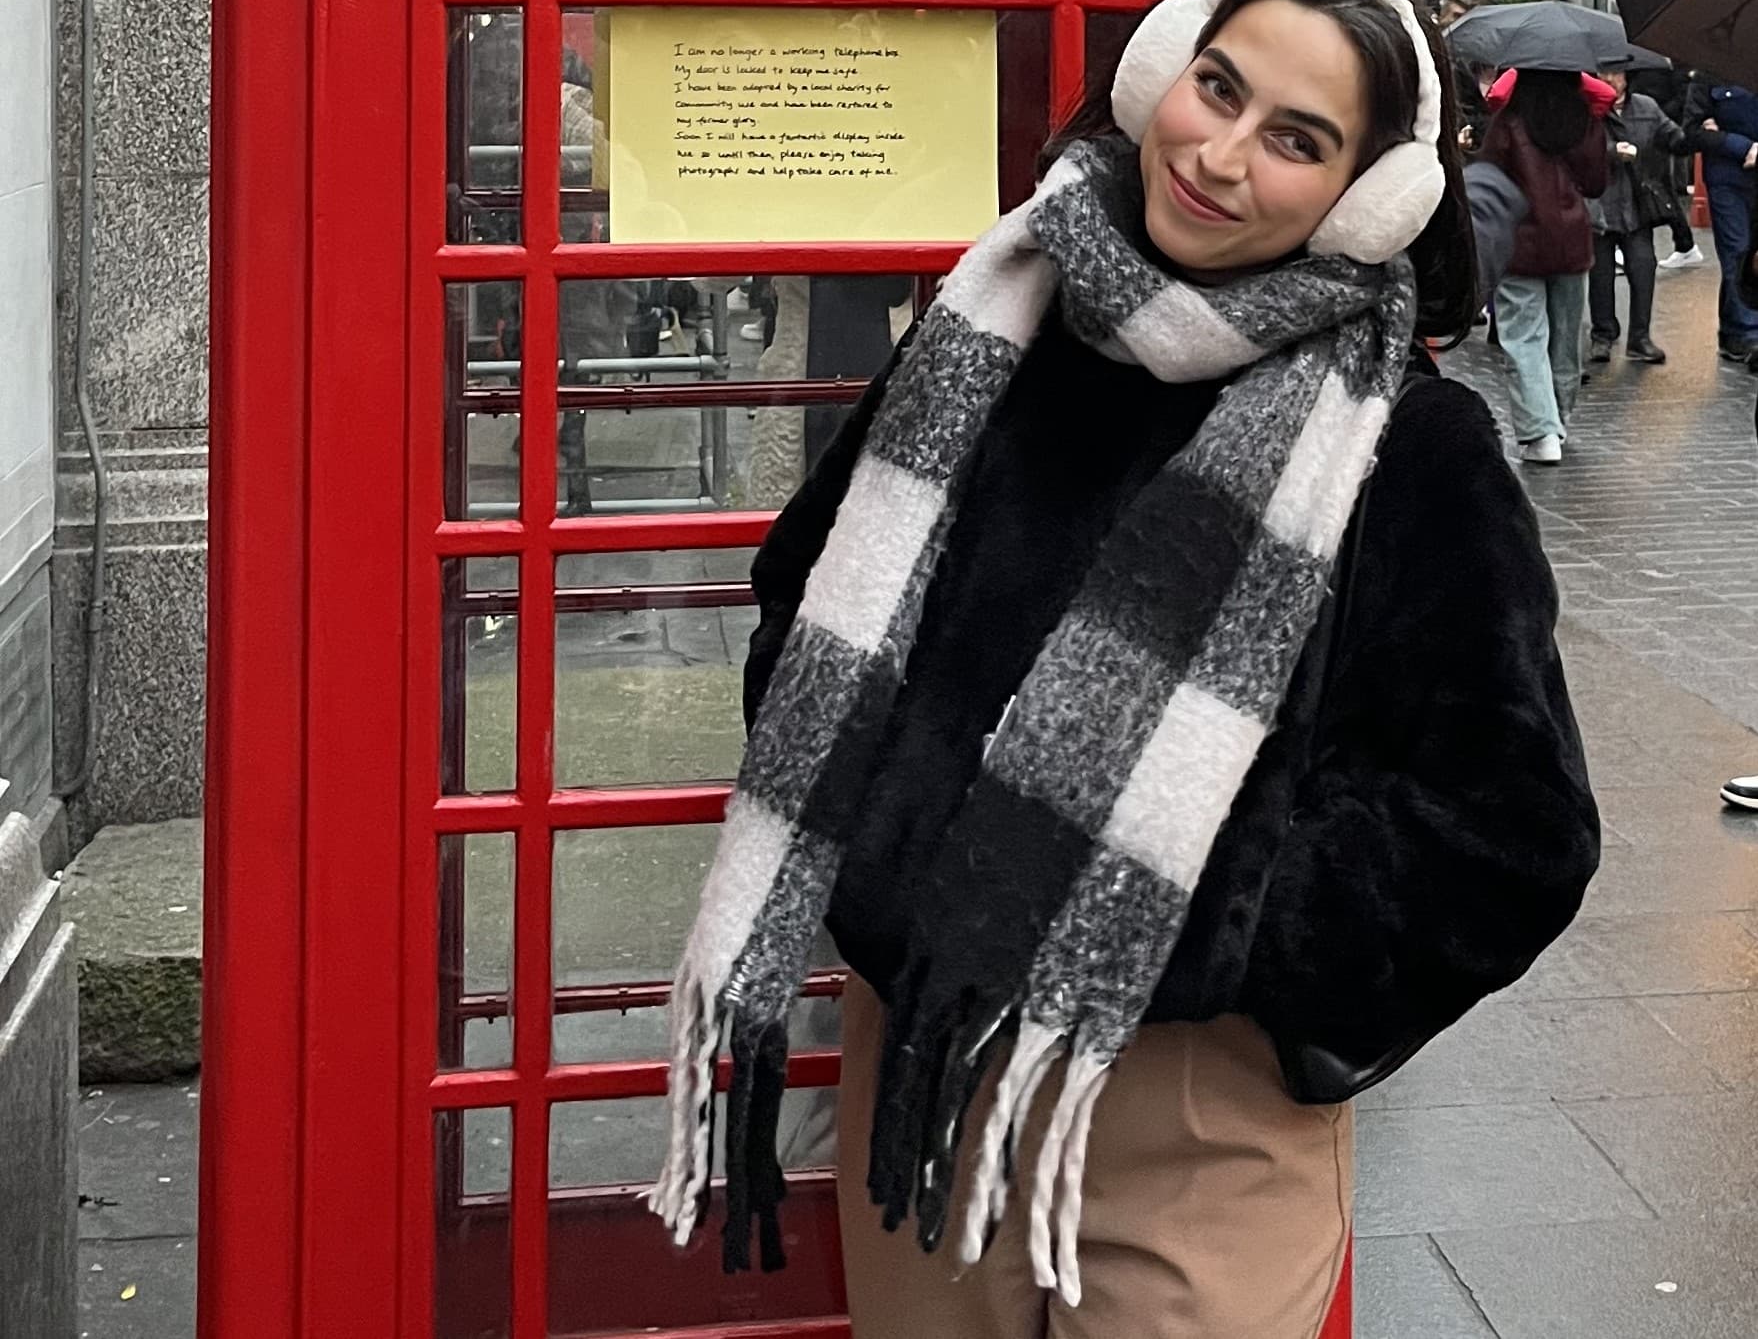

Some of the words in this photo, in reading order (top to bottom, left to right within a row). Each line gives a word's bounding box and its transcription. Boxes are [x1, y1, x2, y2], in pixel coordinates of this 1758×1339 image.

[673, 43, 685, 56] I
[688, 48, 705, 56] am
[710, 48, 725, 56] no
[728, 45, 763, 61] longer
[782, 47, 825, 60] working
[834, 47, 883, 61] telephone
[675, 65, 691, 80] My
[696, 65, 719, 74] door
[722, 65, 730, 74] is
[736, 65, 766, 74] locked
[673, 82, 682, 93] I
[688, 83, 711, 91] have
[717, 81, 736, 91] been
[742, 81, 781, 93] adopted
[787, 83, 798, 95] by
[836, 83, 872, 95] charity
[875, 84, 890, 93] for
[784, 100, 807, 108] have
[810, 100, 833, 108] been
[836, 101, 878, 109] restored
[676, 117, 692, 128] my
[696, 116, 729, 126] former
[674, 131, 702, 140] Soon
[706, 132, 714, 140] I
[718, 132, 735, 140] will
[742, 133, 766, 141] have
[778, 131, 827, 144] fantastic
[833, 131, 870, 144] display
[875, 128, 905, 140] inside
[718, 150, 743, 158] until
[780, 149, 815, 162] please
[819, 150, 845, 162] enjoy
[850, 149, 885, 163] taking
[678, 166, 739, 178] photographs
[747, 167, 765, 175] and
[773, 167, 794, 179] help
[796, 167, 823, 175] take
[828, 168, 854, 176] care
[859, 168, 872, 178] of
